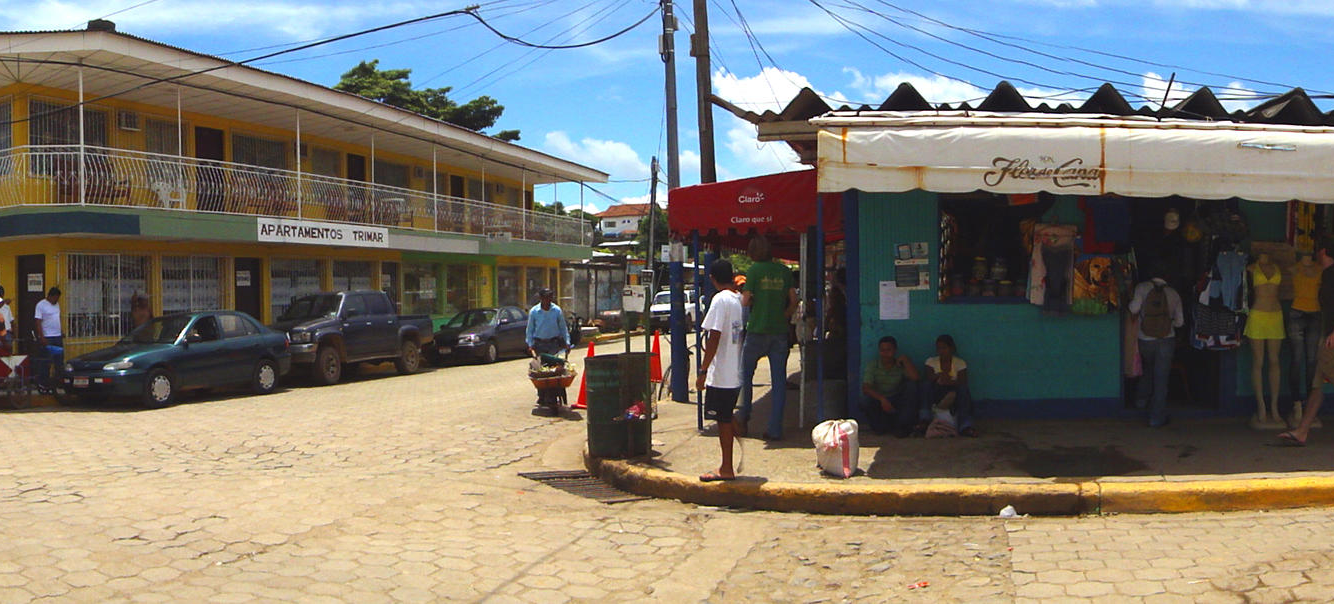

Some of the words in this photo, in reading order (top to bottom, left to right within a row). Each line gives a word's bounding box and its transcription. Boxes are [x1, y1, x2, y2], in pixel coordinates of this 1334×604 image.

[738, 194, 761, 204] Claro
[730, 216, 750, 224] Claro
[751, 216, 764, 224] que
[260, 223, 343, 241] APARTAMENTOS
[352, 230, 384, 243] TRIMAR
